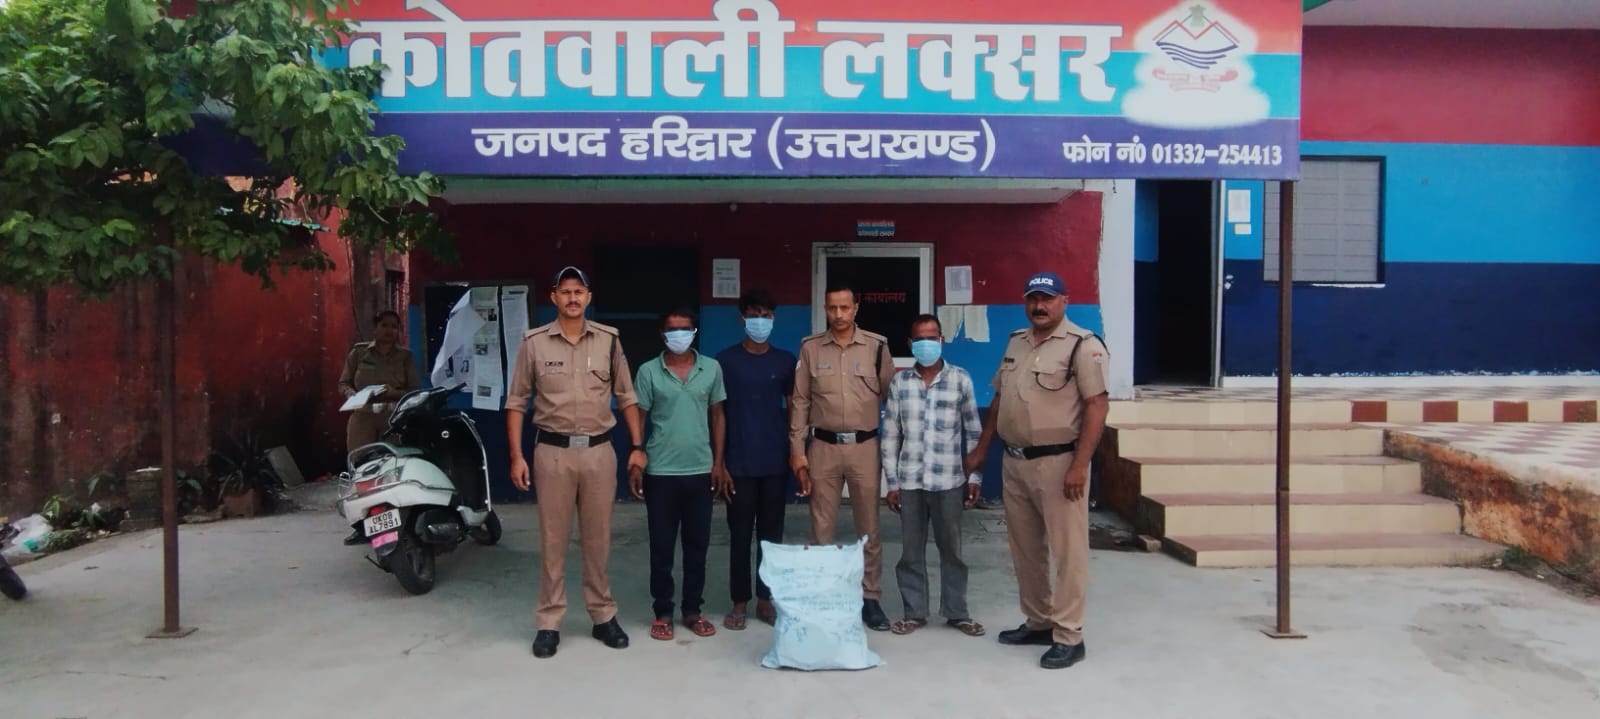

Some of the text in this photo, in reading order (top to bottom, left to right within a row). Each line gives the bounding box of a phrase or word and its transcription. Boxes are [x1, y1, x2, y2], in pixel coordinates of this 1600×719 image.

[344, 0, 1123, 101] कोतवाली लक्सर
[471, 115, 996, 171] जनपद हरिद्वार (उत्तराखण्ड)
[1062, 134, 1112, 163] फोन
[1151, 143, 1283, 166] 01332-254413
[1028, 277, 1054, 287] POLICE
